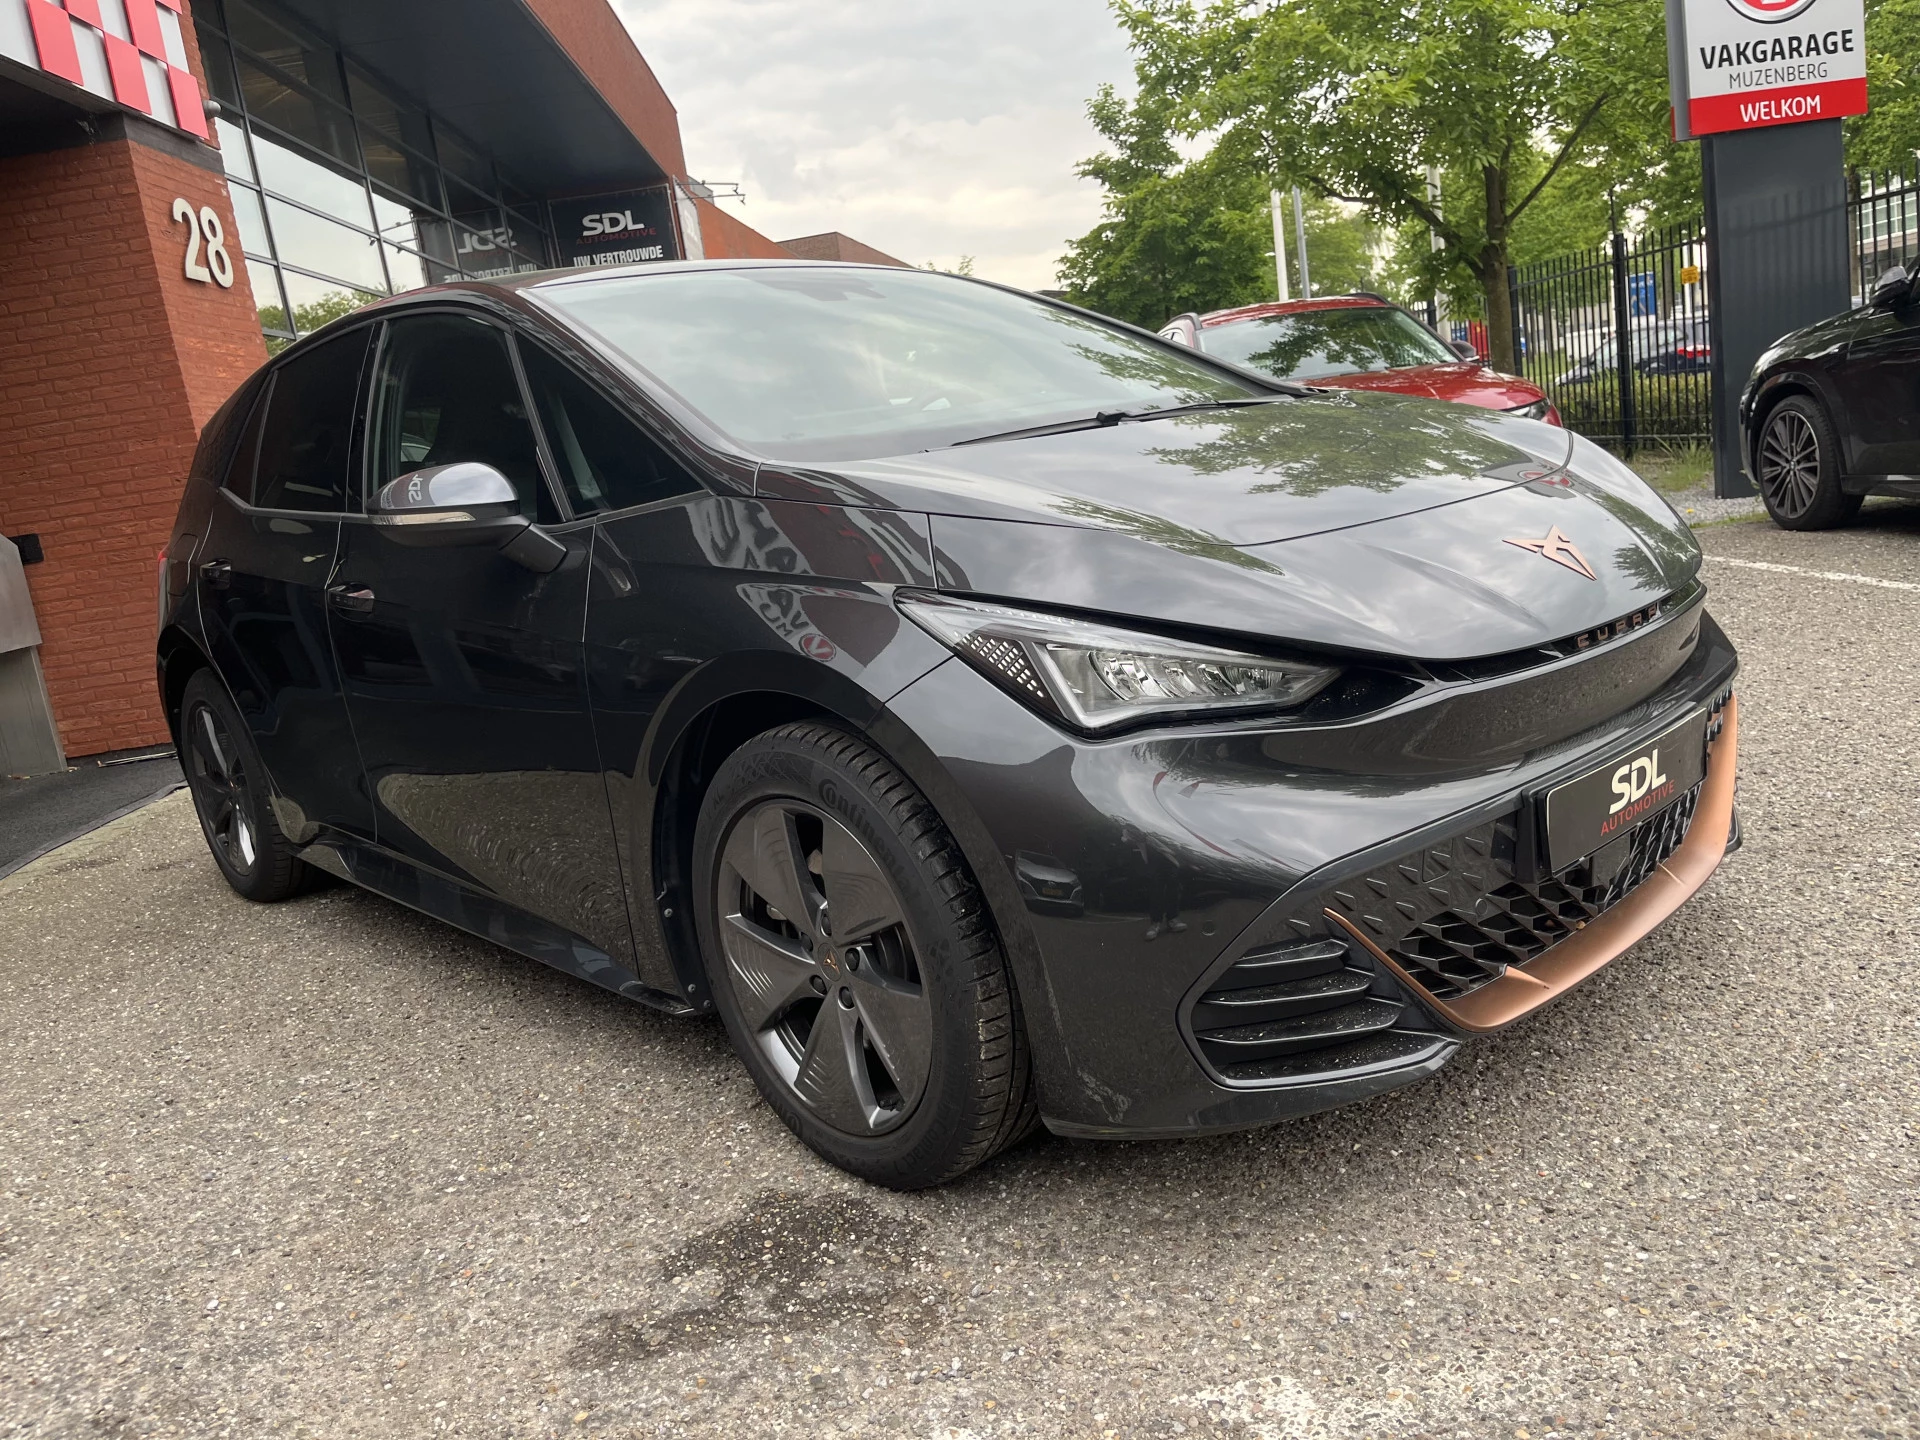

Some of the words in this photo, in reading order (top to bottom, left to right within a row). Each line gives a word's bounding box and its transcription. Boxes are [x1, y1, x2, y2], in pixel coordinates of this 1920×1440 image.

[1700, 29, 1854, 70] VAKGARAGE
[1729, 62, 1828, 89] MUZENBERG
[1740, 95, 1821, 123] WELKOM
[576, 228, 657, 245] AUTOMOTIVE
[582, 210, 645, 237] SDL
[173, 198, 234, 288] 28
[573, 255, 591, 268] UW
[593, 245, 664, 266] VERTROUWDE
[1609, 749, 1666, 814] SDL
[1600, 780, 1676, 837] AUTOMOTIVE
